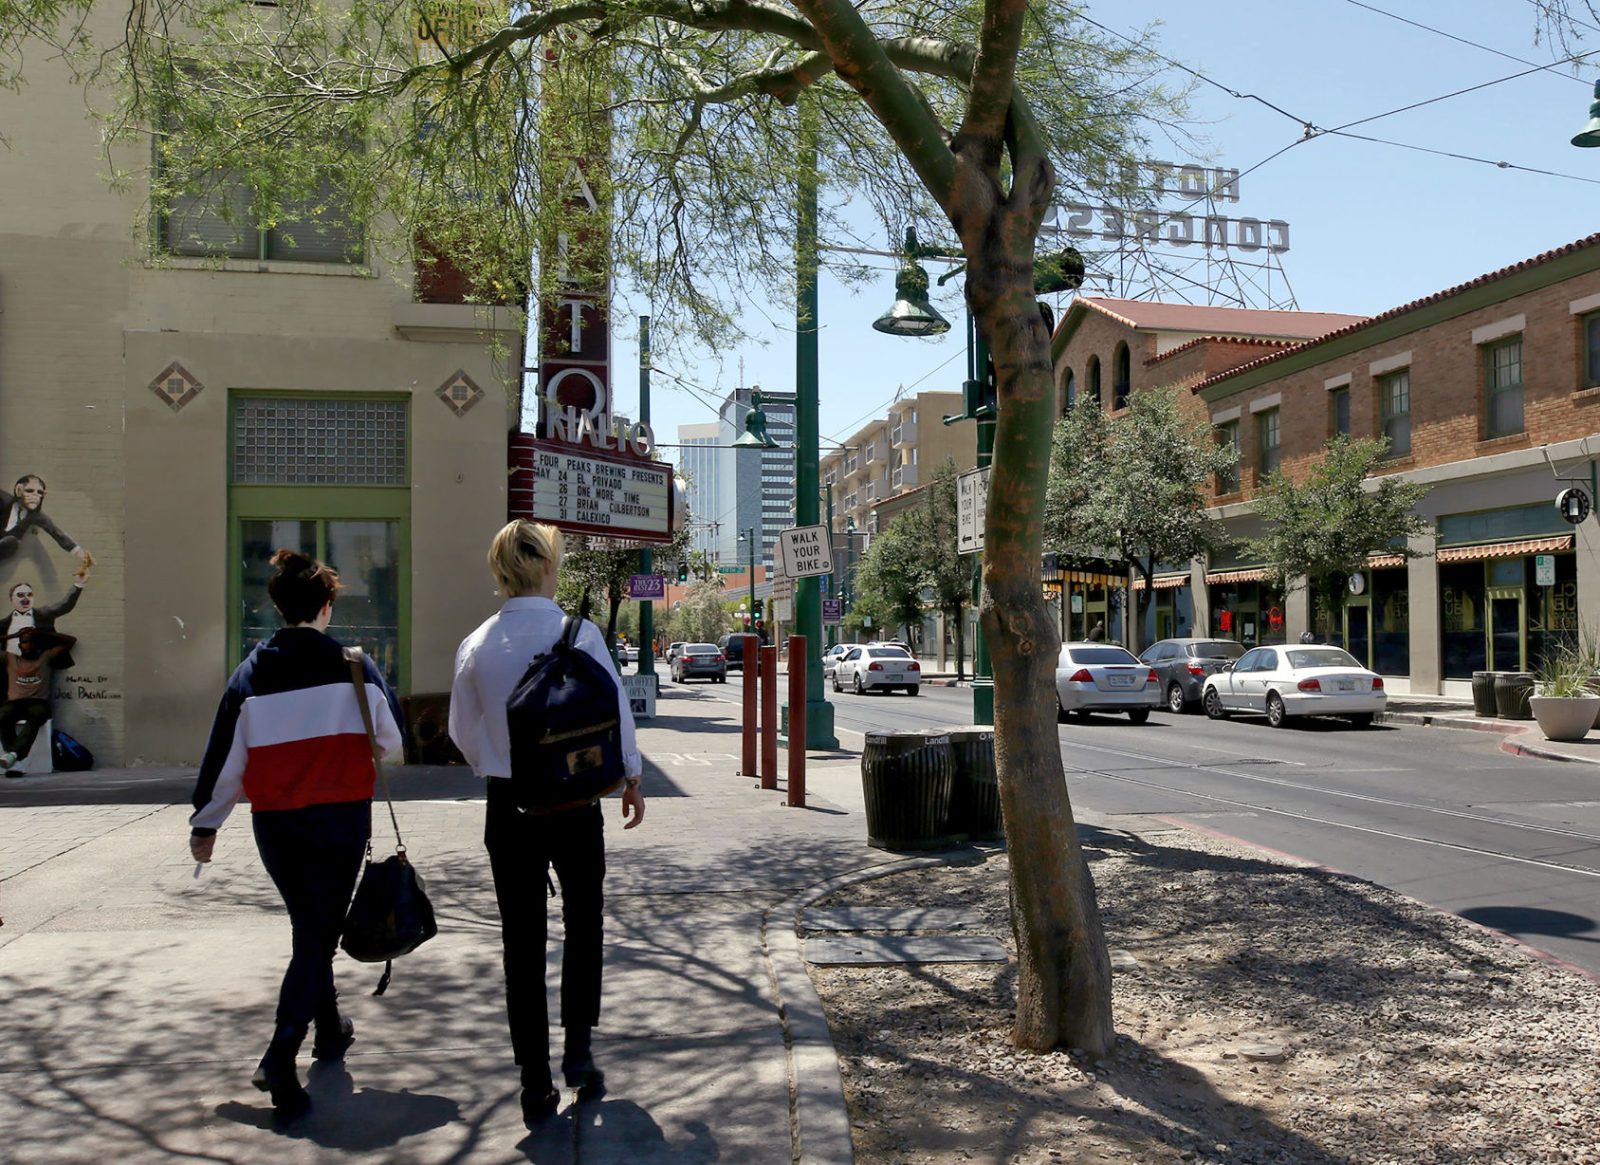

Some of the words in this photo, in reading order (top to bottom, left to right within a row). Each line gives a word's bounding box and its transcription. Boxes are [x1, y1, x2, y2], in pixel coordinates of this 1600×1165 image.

[546, 404, 655, 457] RIALTO
[533, 466, 550, 479] MAY
[558, 471, 568, 482] 24
[577, 473, 586, 485] EL
[592, 475, 622, 490] PRIVADO
[540, 455, 559, 469] FOUR
[567, 459, 591, 473] PEAKS
[595, 464, 626, 479] BREWING
[632, 470, 664, 486] PRESENTS
[577, 486, 591, 498] ONE
[595, 488, 615, 501] MORE
[624, 492, 640, 504] TIME
[559, 496, 568, 507] 27
[577, 498, 599, 511] BRIAN
[609, 502, 650, 517] CULBERTSON
[559, 508, 567, 520] 31
[576, 510, 611, 525] CALEXICO
[791, 531, 818, 545] WALK
[793, 545, 820, 558] YOUR
[797, 559, 820, 571] BIKE
